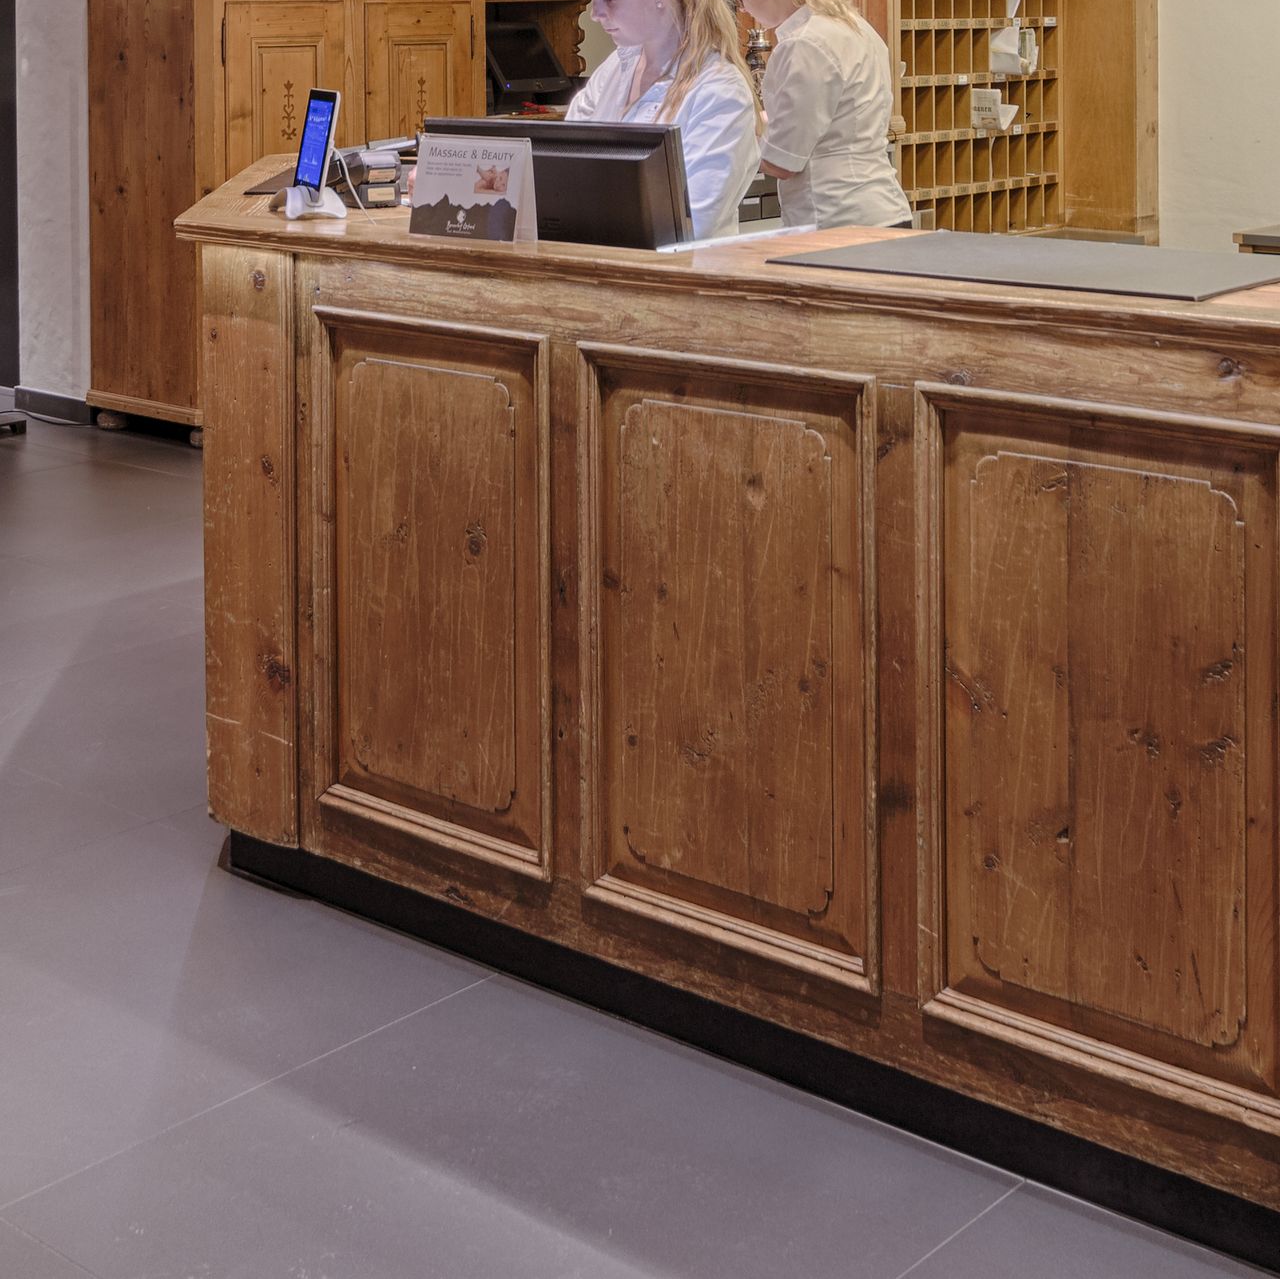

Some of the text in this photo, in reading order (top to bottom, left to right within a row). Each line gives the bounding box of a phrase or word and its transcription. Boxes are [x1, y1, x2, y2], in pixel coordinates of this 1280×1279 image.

[429, 146, 514, 161] MASSAGE & BEAUTY
